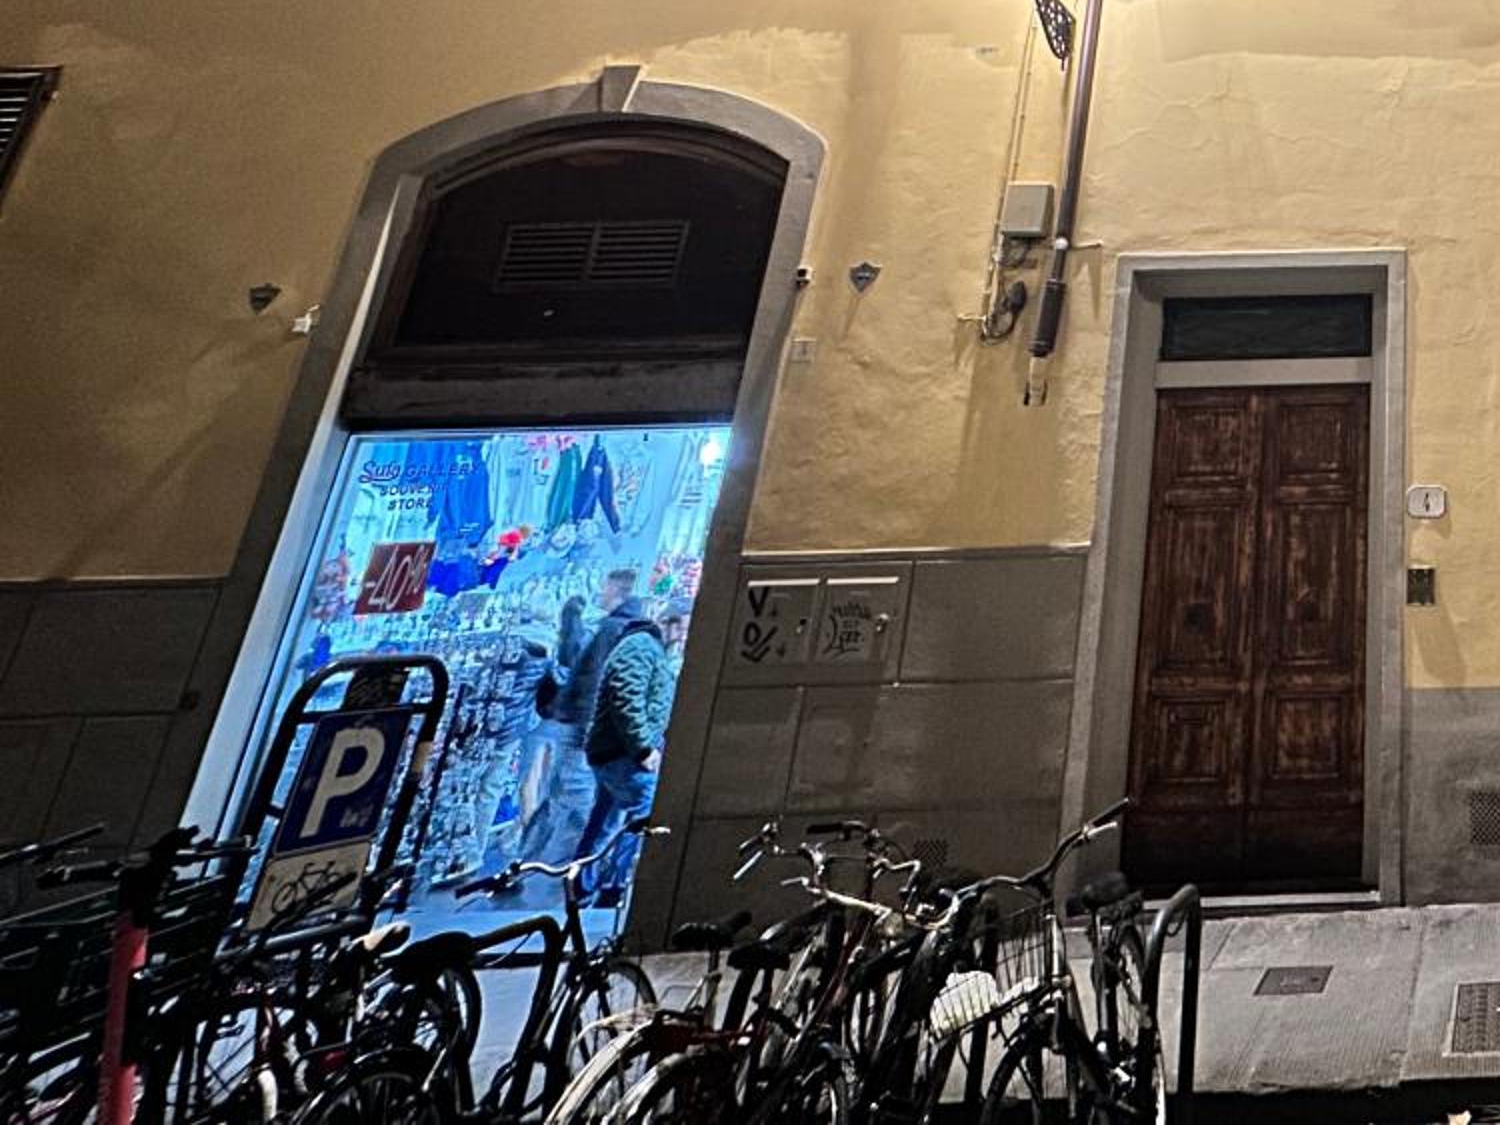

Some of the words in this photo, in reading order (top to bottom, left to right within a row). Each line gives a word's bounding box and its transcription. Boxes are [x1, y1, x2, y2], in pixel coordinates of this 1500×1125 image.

[387, 497, 434, 511] STORE
[365, 544, 431, 611] -40%
[299, 728, 386, 838] P
